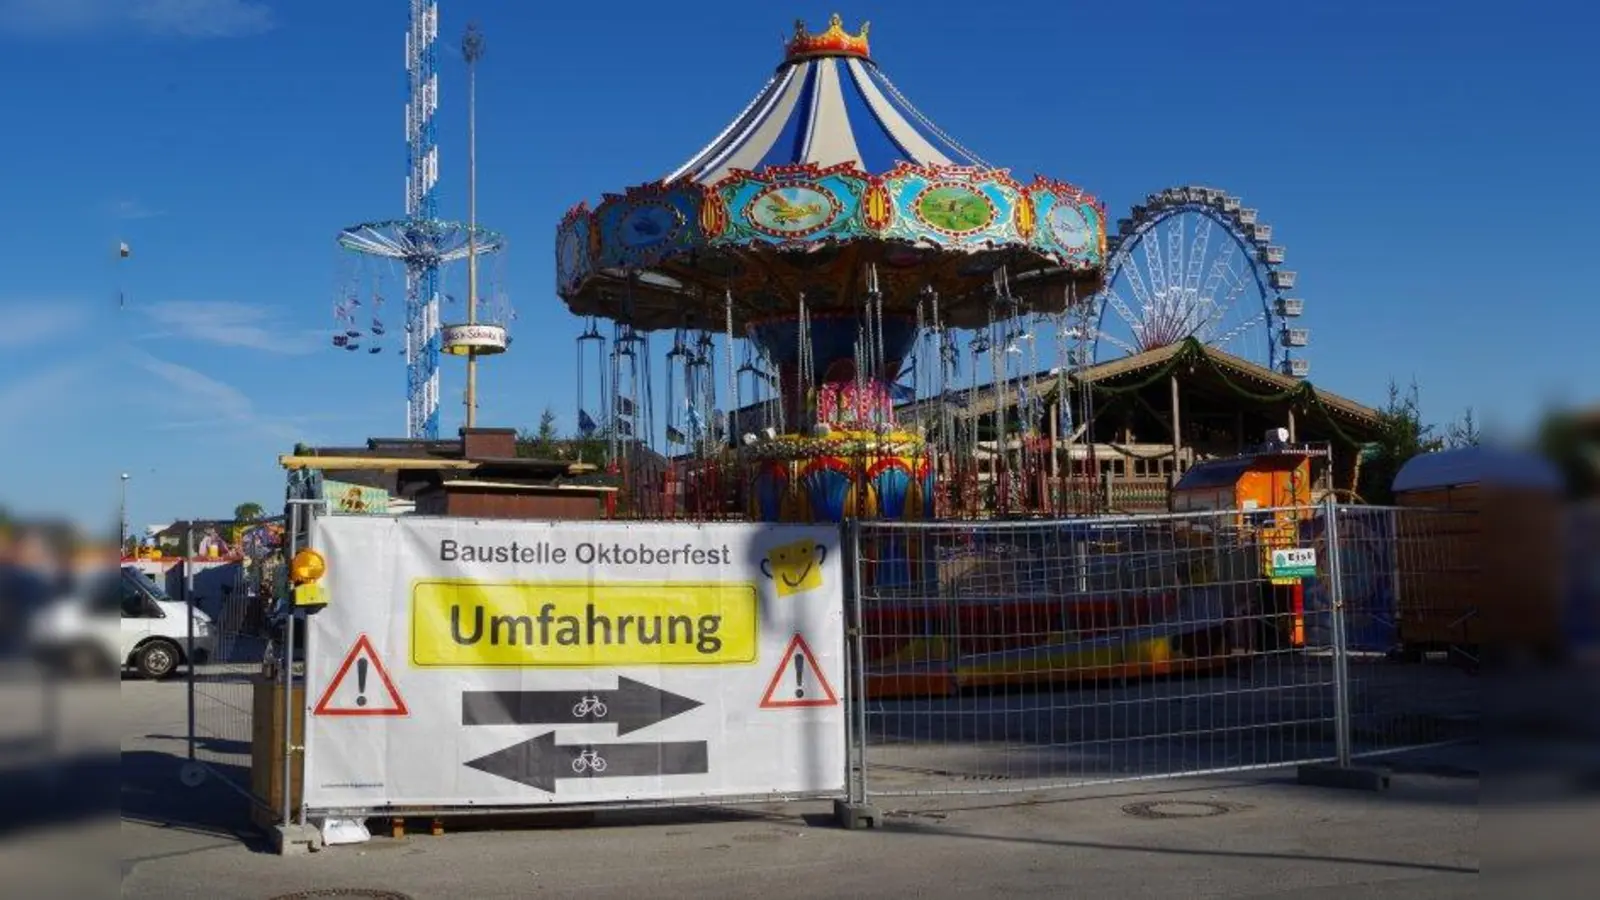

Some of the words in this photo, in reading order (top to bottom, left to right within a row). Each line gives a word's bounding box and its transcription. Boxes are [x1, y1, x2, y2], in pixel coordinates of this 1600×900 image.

[440, 539, 567, 564] Baustelle
[575, 542, 731, 565] Oktoberfest
[451, 603, 722, 654] Umfahrung
